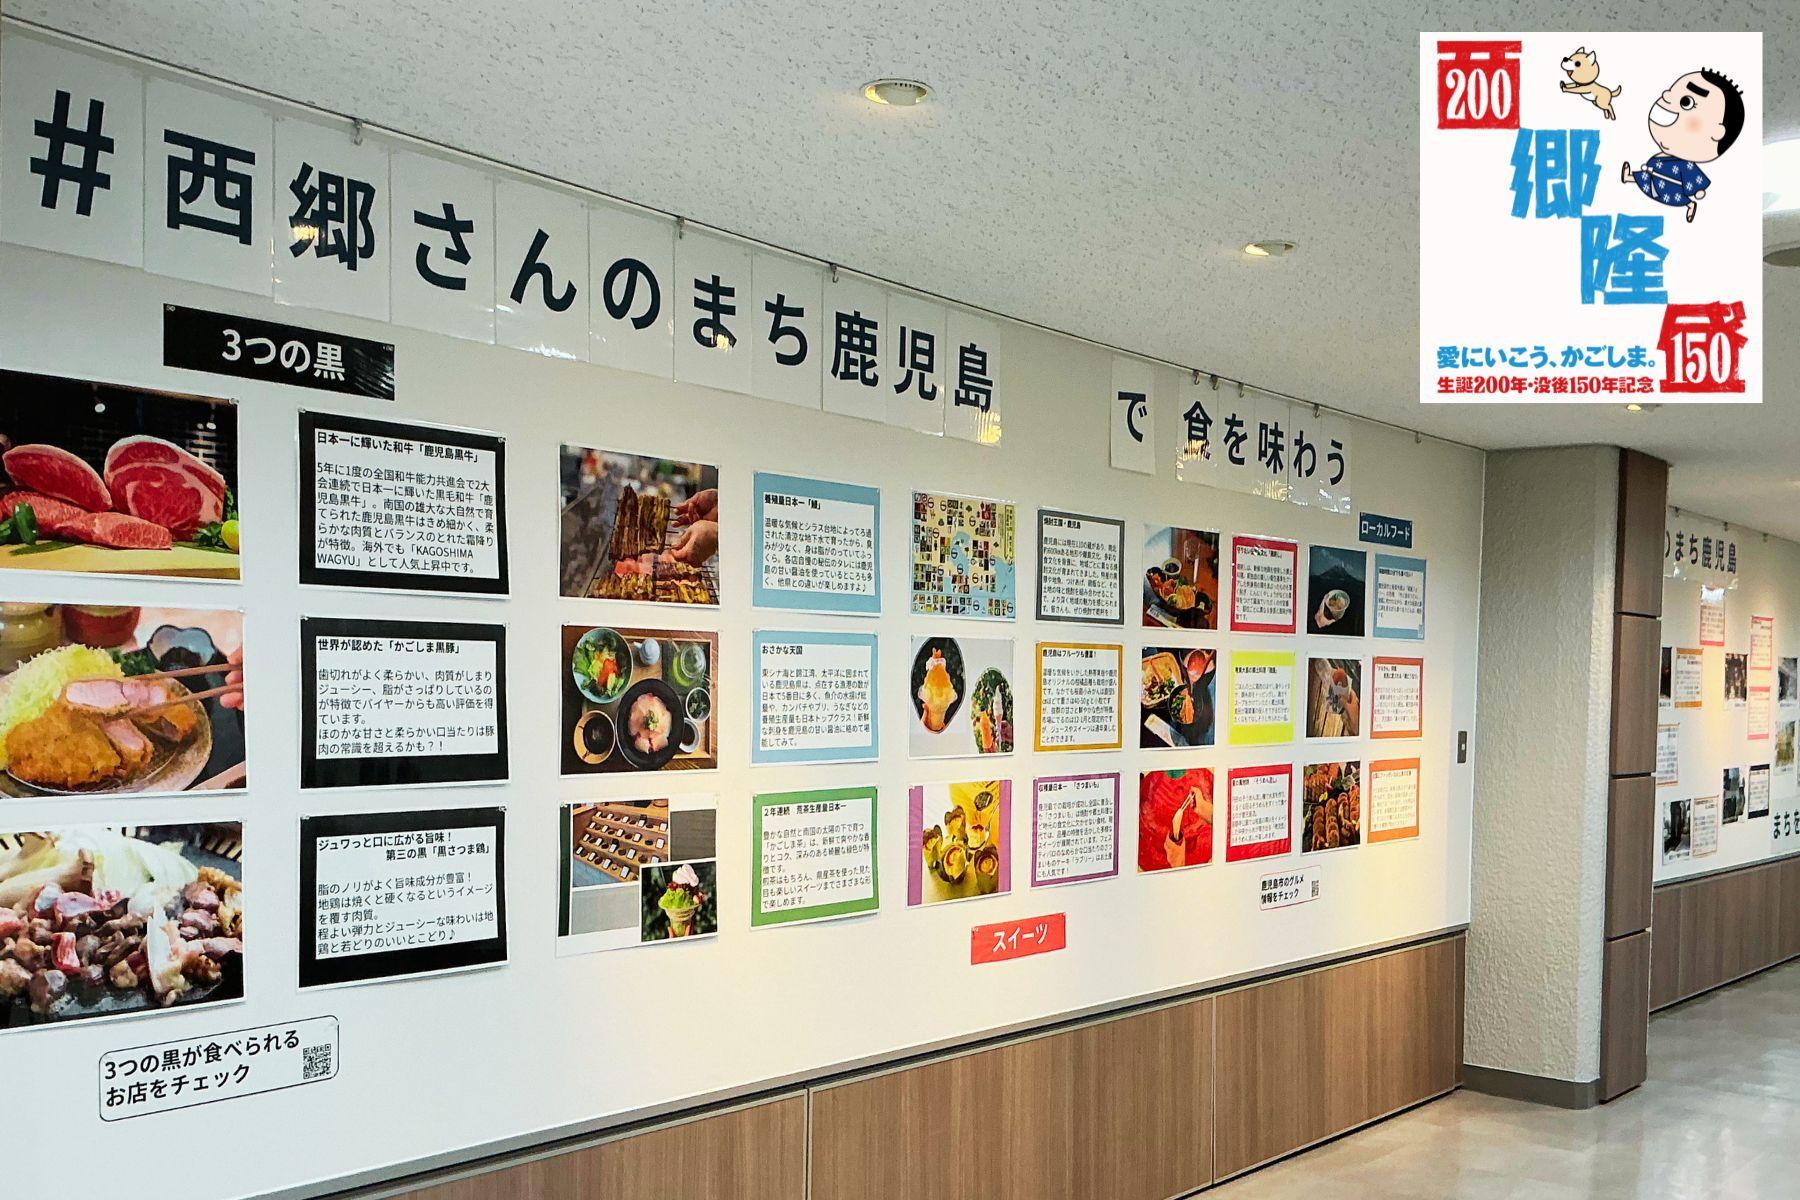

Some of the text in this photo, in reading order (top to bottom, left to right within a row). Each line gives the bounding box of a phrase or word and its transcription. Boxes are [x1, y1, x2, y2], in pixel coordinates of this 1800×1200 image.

[221, 328, 345, 382] 3つの黒
[317, 431, 479, 463] 日本一に輝いた和牛「鹿児島黒牛」
[1117, 391, 1148, 443] で
[1183, 401, 1345, 486] 食を味わう
[317, 463, 490, 491] 5年に1度の全国和牛能力共進会で2大
[317, 477, 493, 506] 会連続で日本一に輝いた黒毛和牛「鹿
[317, 493, 493, 519] 児島黒牛」。南国の雄大な大自然で育
[318, 508, 494, 533] てられた鹿児島黒牛はきめ細かく、柔
[1362, 521, 1410, 540] ローカルフード
[318, 524, 493, 546] らかな肉質とバランスのとれた霜降り
[318, 639, 460, 654] 世界が認めた「かごしま黒豚」
[319, 669, 492, 681] 歯切れがよく柔らかい、肉質がしまり
[319, 684, 492, 696] ジューシー、脂がさっぱりしているの
[319, 698, 493, 710] が特徴でバイヤーからも高い評価を得
[319, 714, 366, 725] ています。
[319, 726, 494, 740] ほのかな甘さと柔らかい口当たりは豚
[1262, 874, 1304, 891] 鹿児島市のグルメ
[1261, 888, 1299, 904] 情報をチェック
[318, 910, 379, 925] を覆す肉質。
[992, 922, 1049, 954] スイーツ
[104, 1029, 300, 1080] 3つの黒が食べられる
[105, 1063, 251, 1108] お店をチェック
